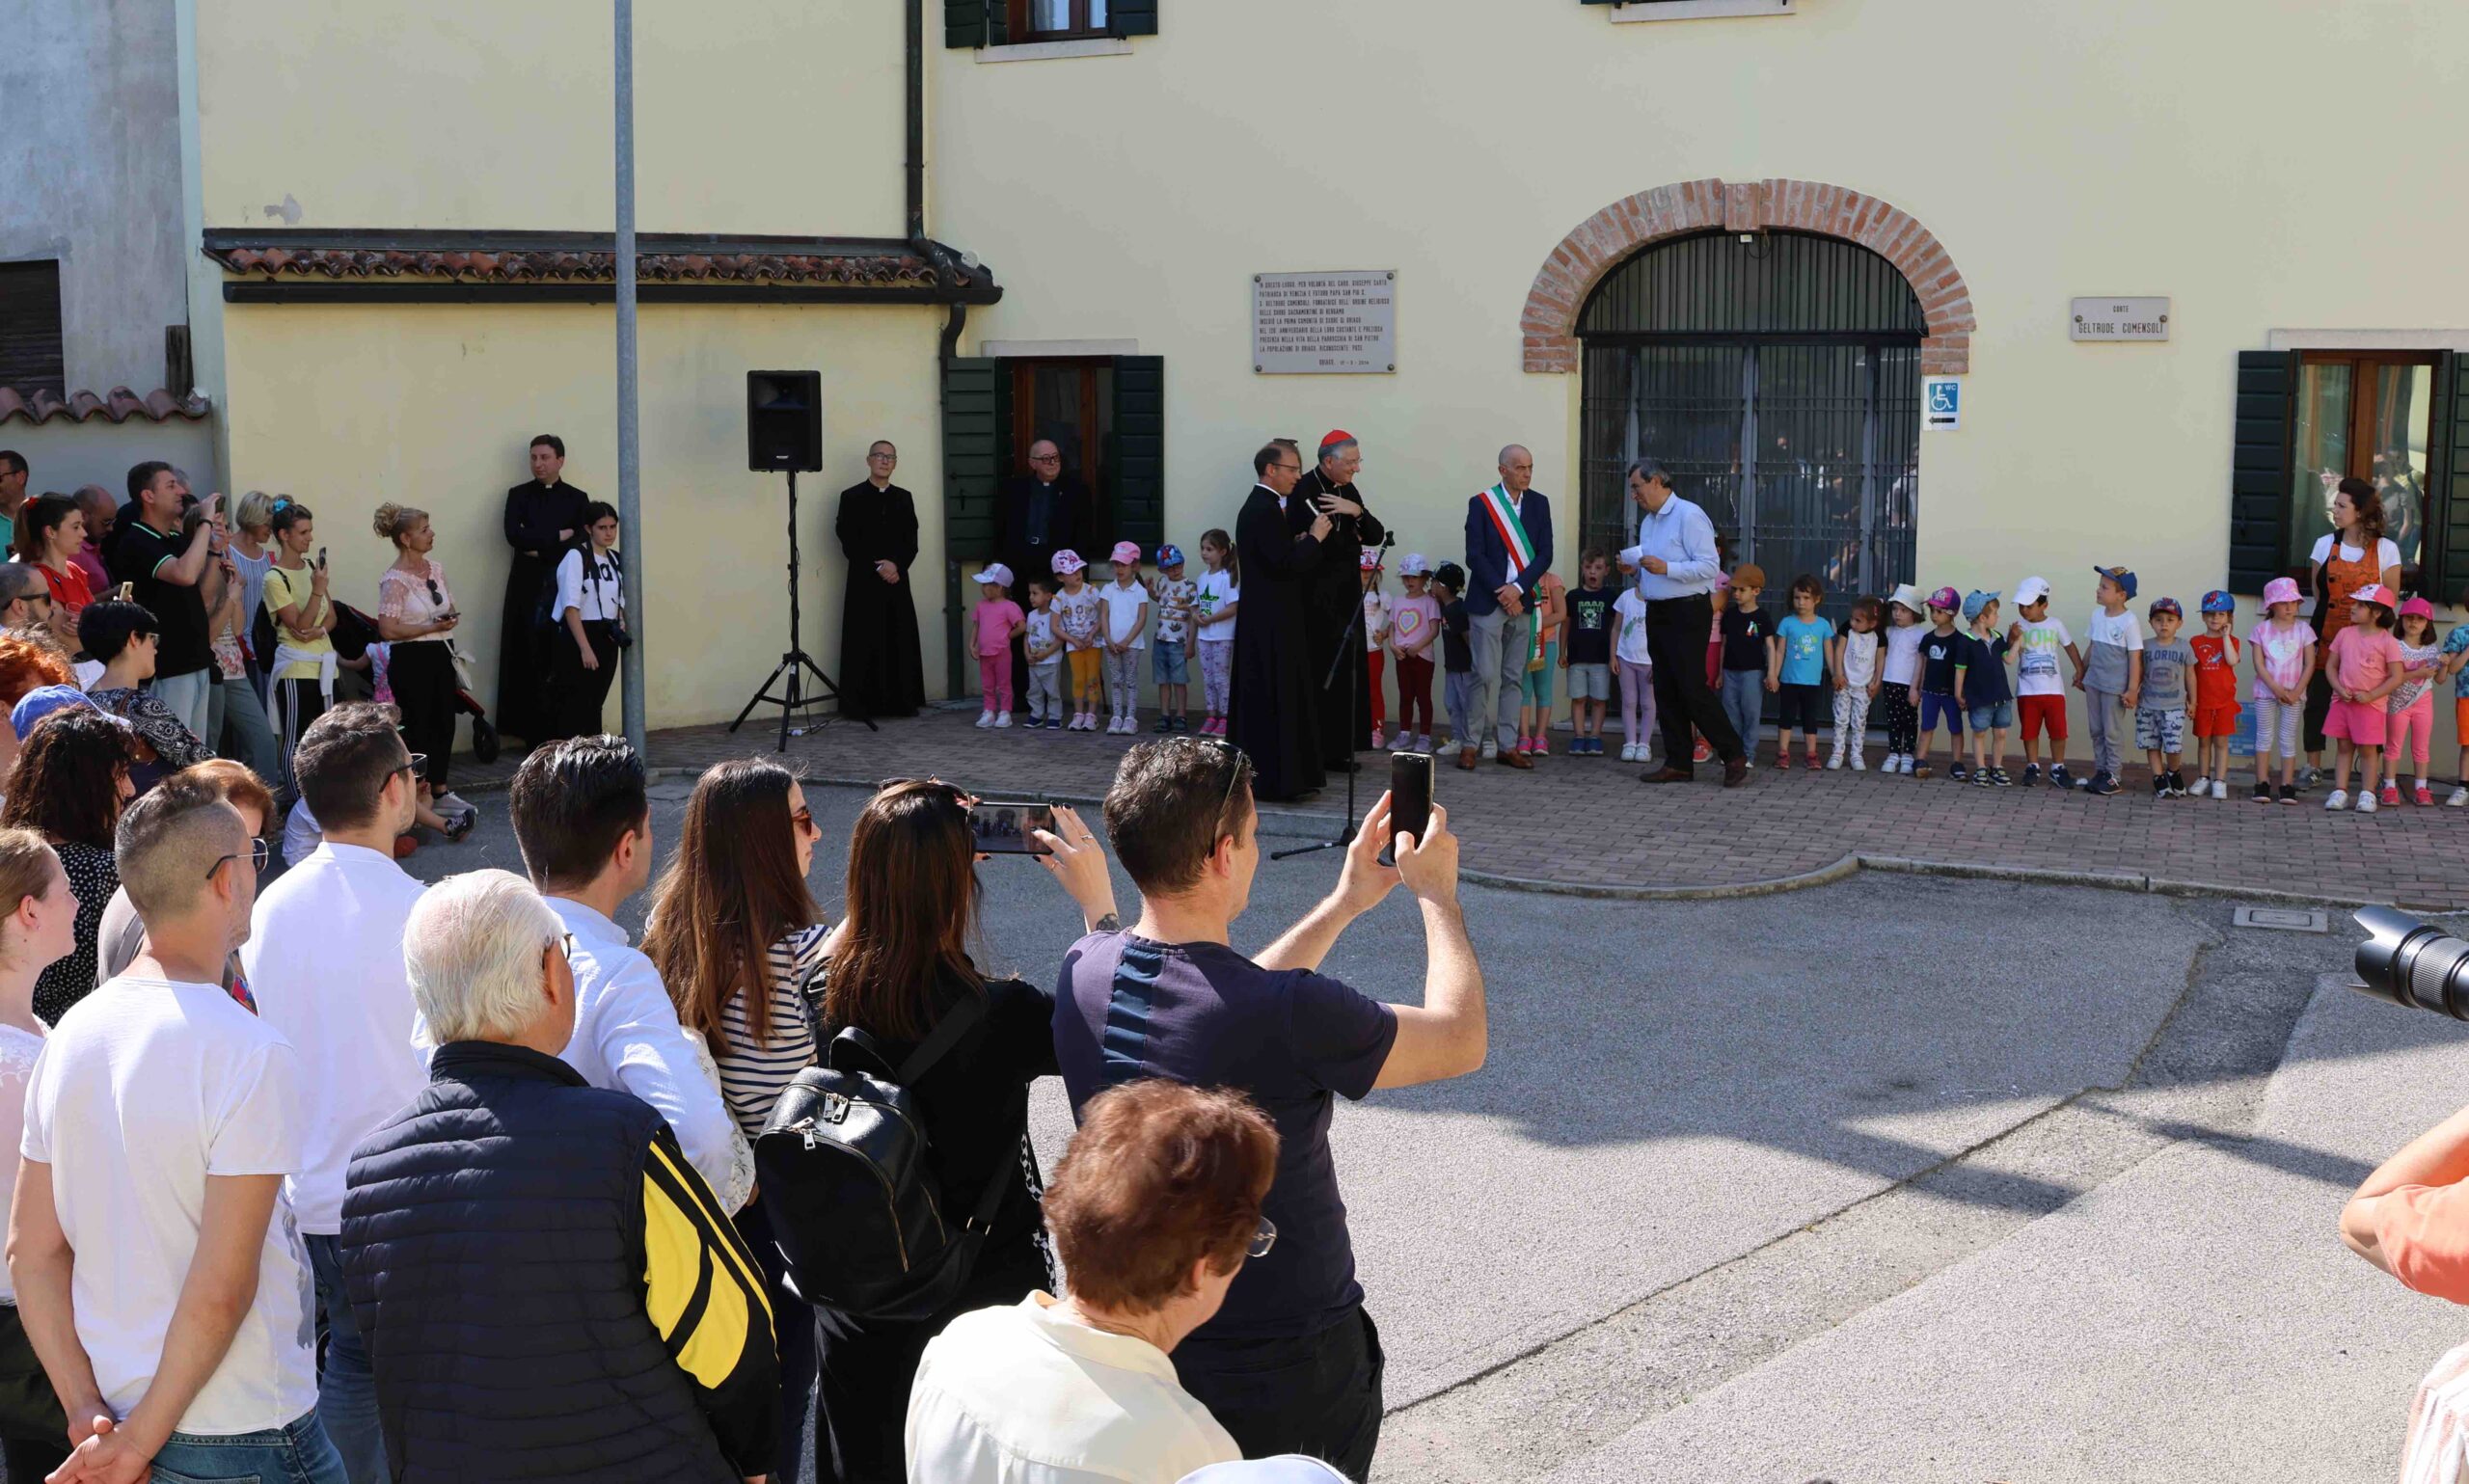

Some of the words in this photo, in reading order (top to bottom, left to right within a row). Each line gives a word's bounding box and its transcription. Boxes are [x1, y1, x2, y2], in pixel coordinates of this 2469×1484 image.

[2078, 323, 2114, 333] GELTRUDE
[2122, 323, 2163, 334] COMENSOLI
[2145, 650, 2184, 665] FLORIDA
